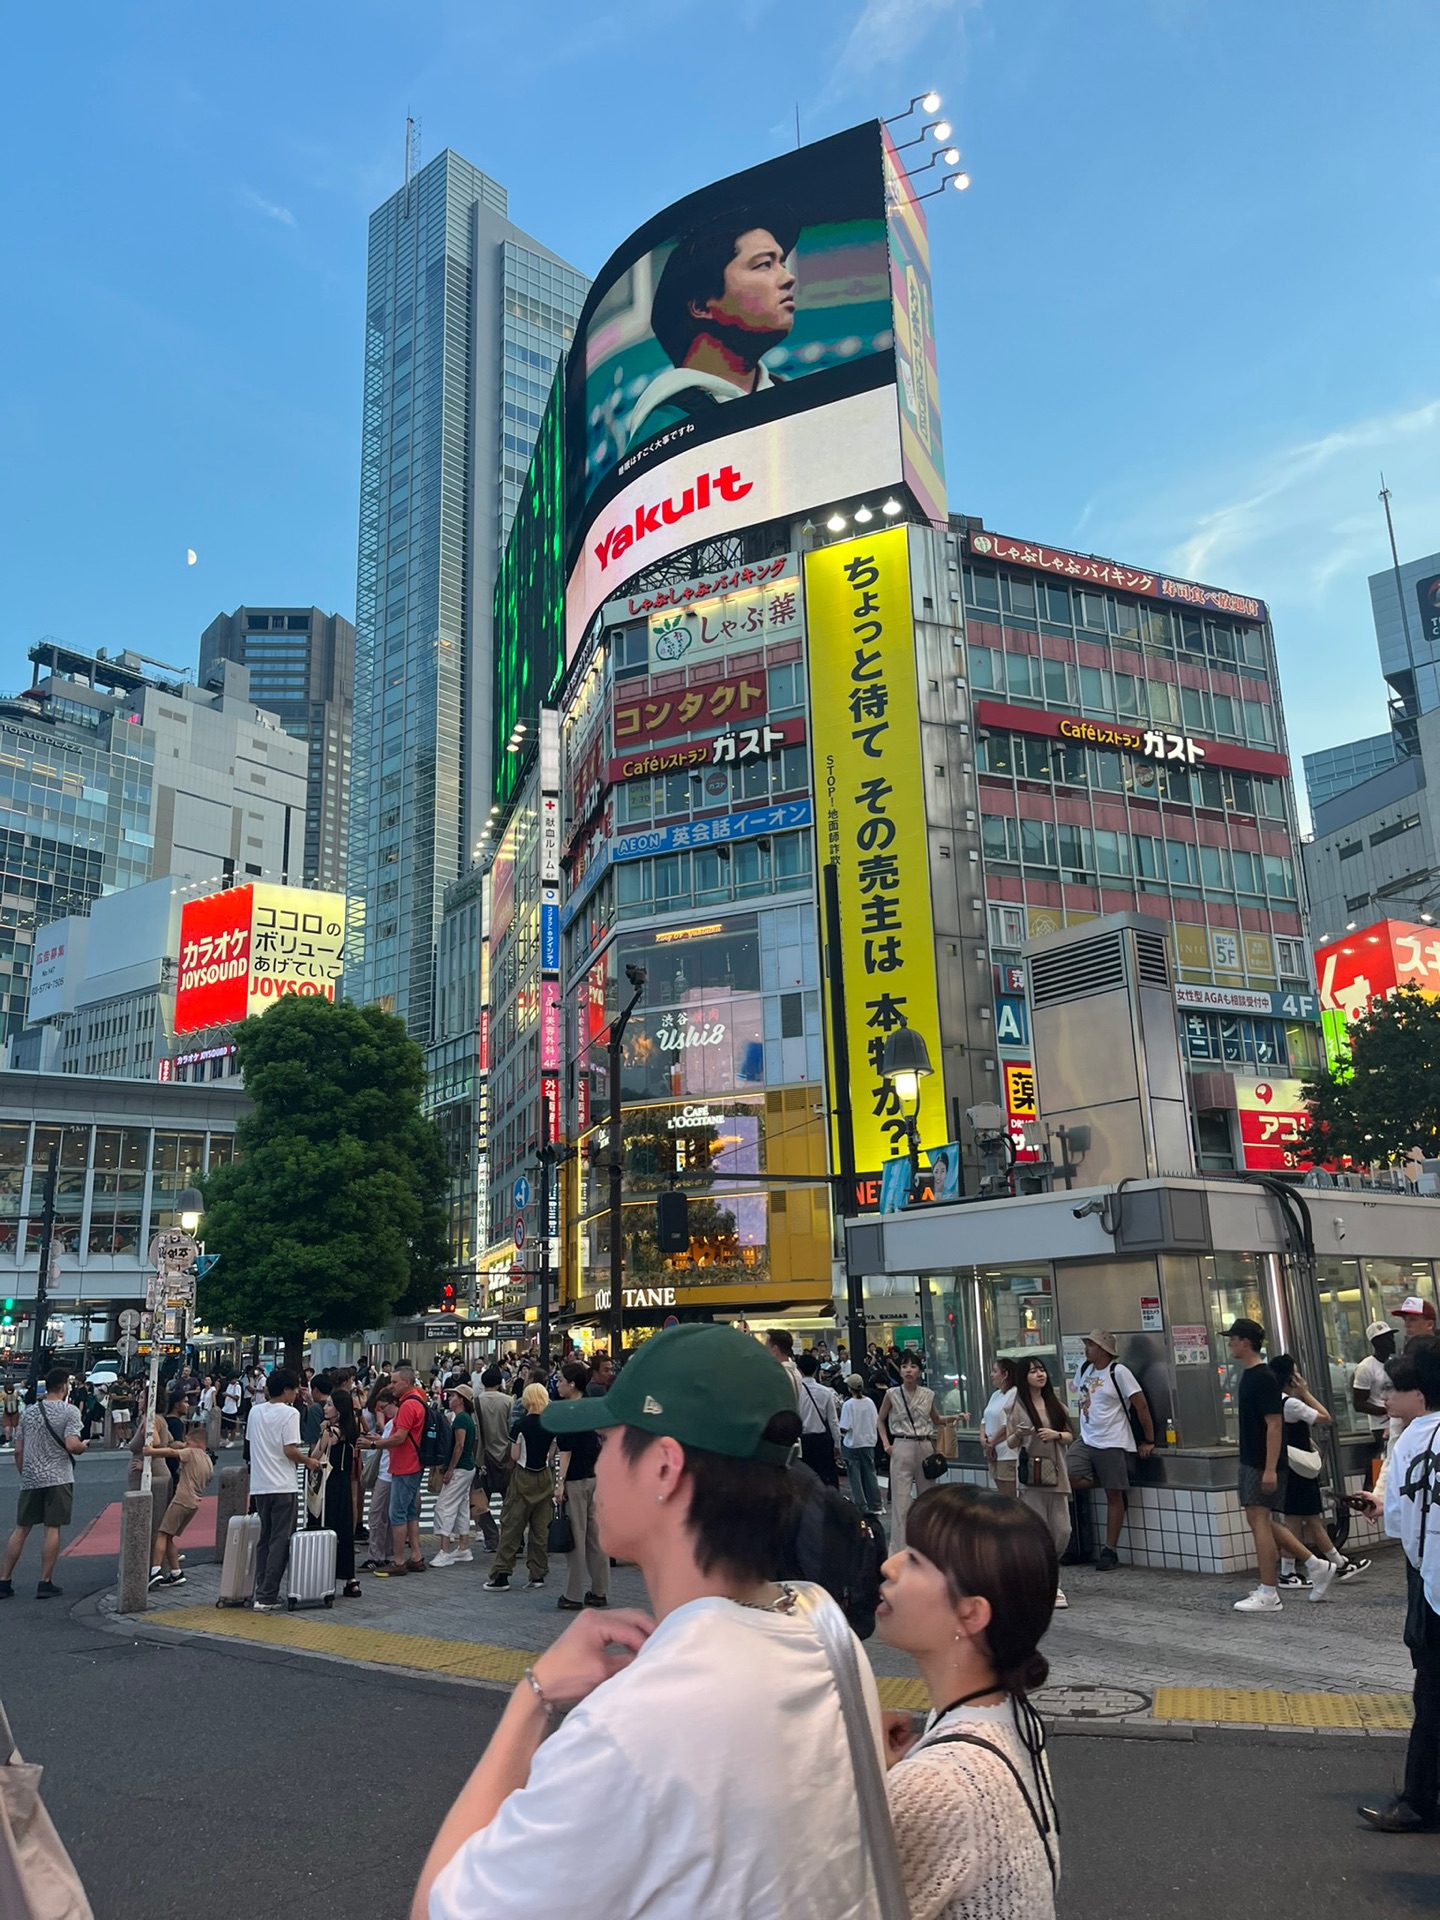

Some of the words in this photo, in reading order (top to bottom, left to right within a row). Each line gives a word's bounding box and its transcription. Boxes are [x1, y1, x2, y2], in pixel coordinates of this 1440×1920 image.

[594, 465, 754, 572] Yakult
[628, 557, 788, 615] しゃぶしゃぶバイキング
[993, 537, 1155, 591] しゃぶしゃぶバイキング
[702, 592, 797, 643] しゃぶ葉
[844, 555, 889, 758] ちょっと待て
[616, 680, 763, 737] コンタクト
[712, 727, 784, 764] ガスト
[1144, 731, 1206, 764] ガスト
[619, 834, 660, 855] AEON
[672, 806, 808, 847] 英会話イーオン
[855, 777, 904, 974] その売主は
[256, 907, 342, 937] ココロの
[182, 928, 249, 970] カラオケ
[1216, 946, 1236, 965] 5F
[180, 957, 248, 992] JOYSOUND
[1282, 994, 1313, 1017] 4F
[543, 1060, 556, 1068] 4F
